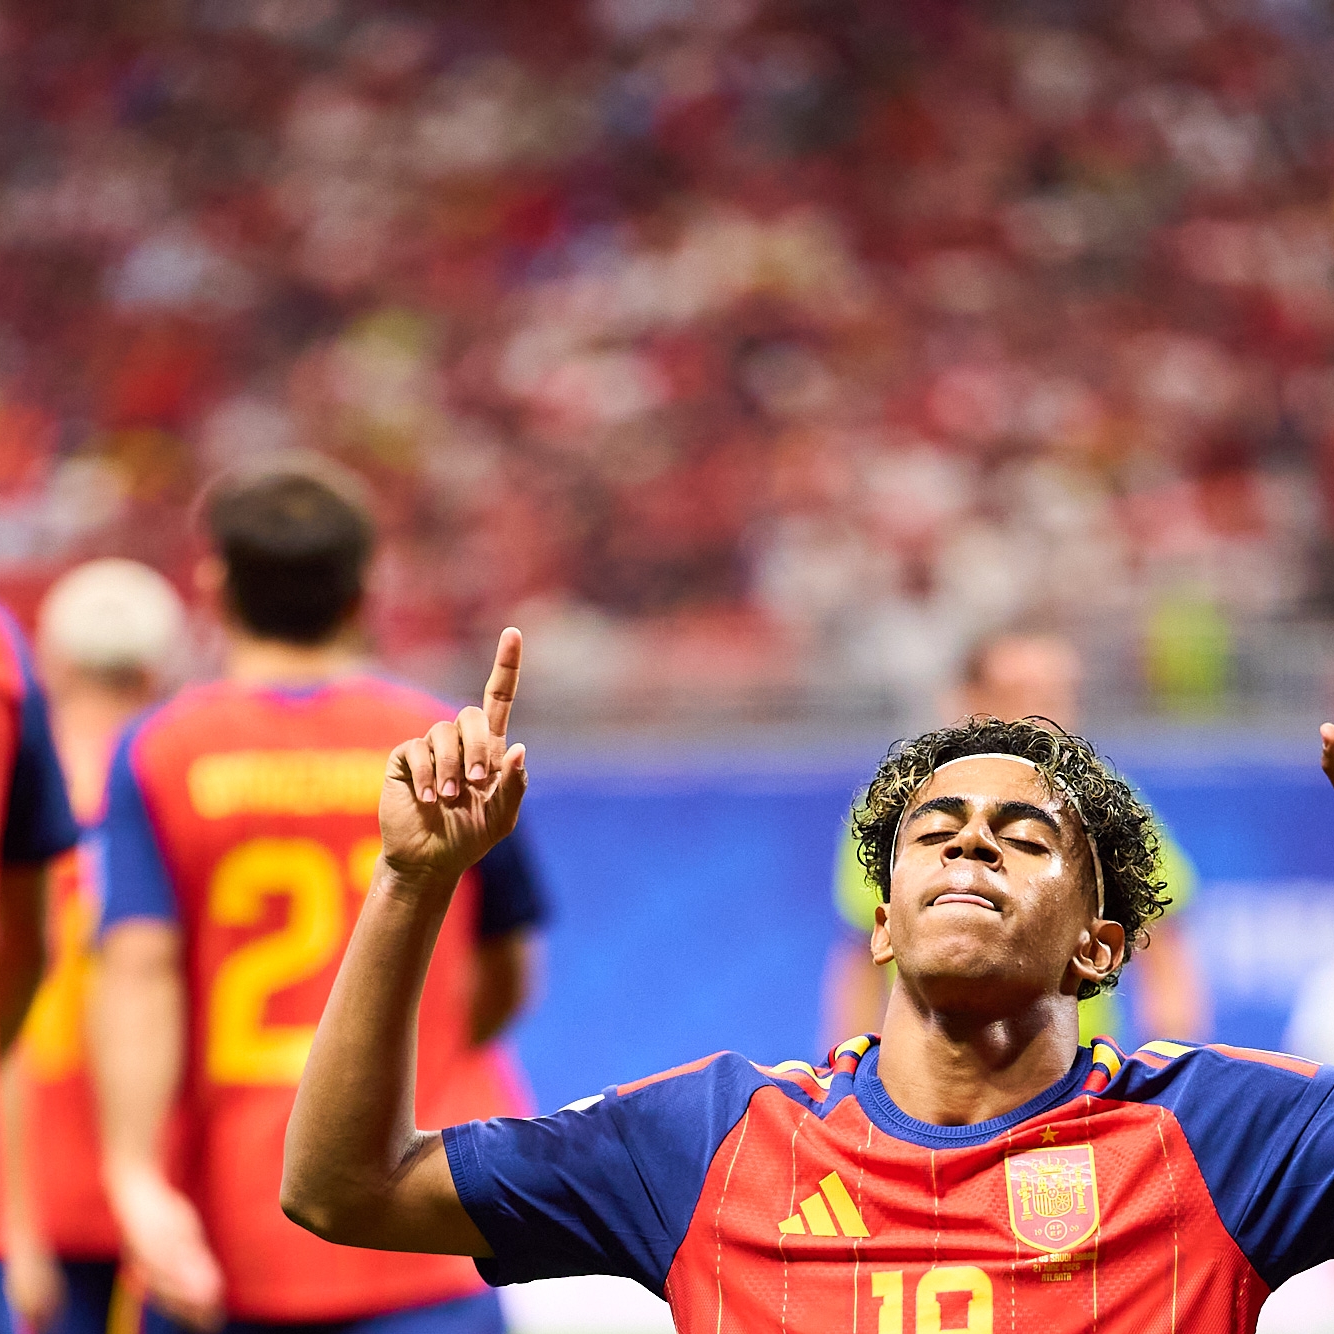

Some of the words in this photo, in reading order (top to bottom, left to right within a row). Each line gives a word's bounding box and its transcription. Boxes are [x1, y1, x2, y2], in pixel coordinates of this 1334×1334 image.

[208, 834, 383, 1087] 2
[1049, 1253, 1072, 1263] SAUDI
[1033, 1263, 1041, 1273] 21
[1041, 1272, 1072, 1282] ATLANTA
